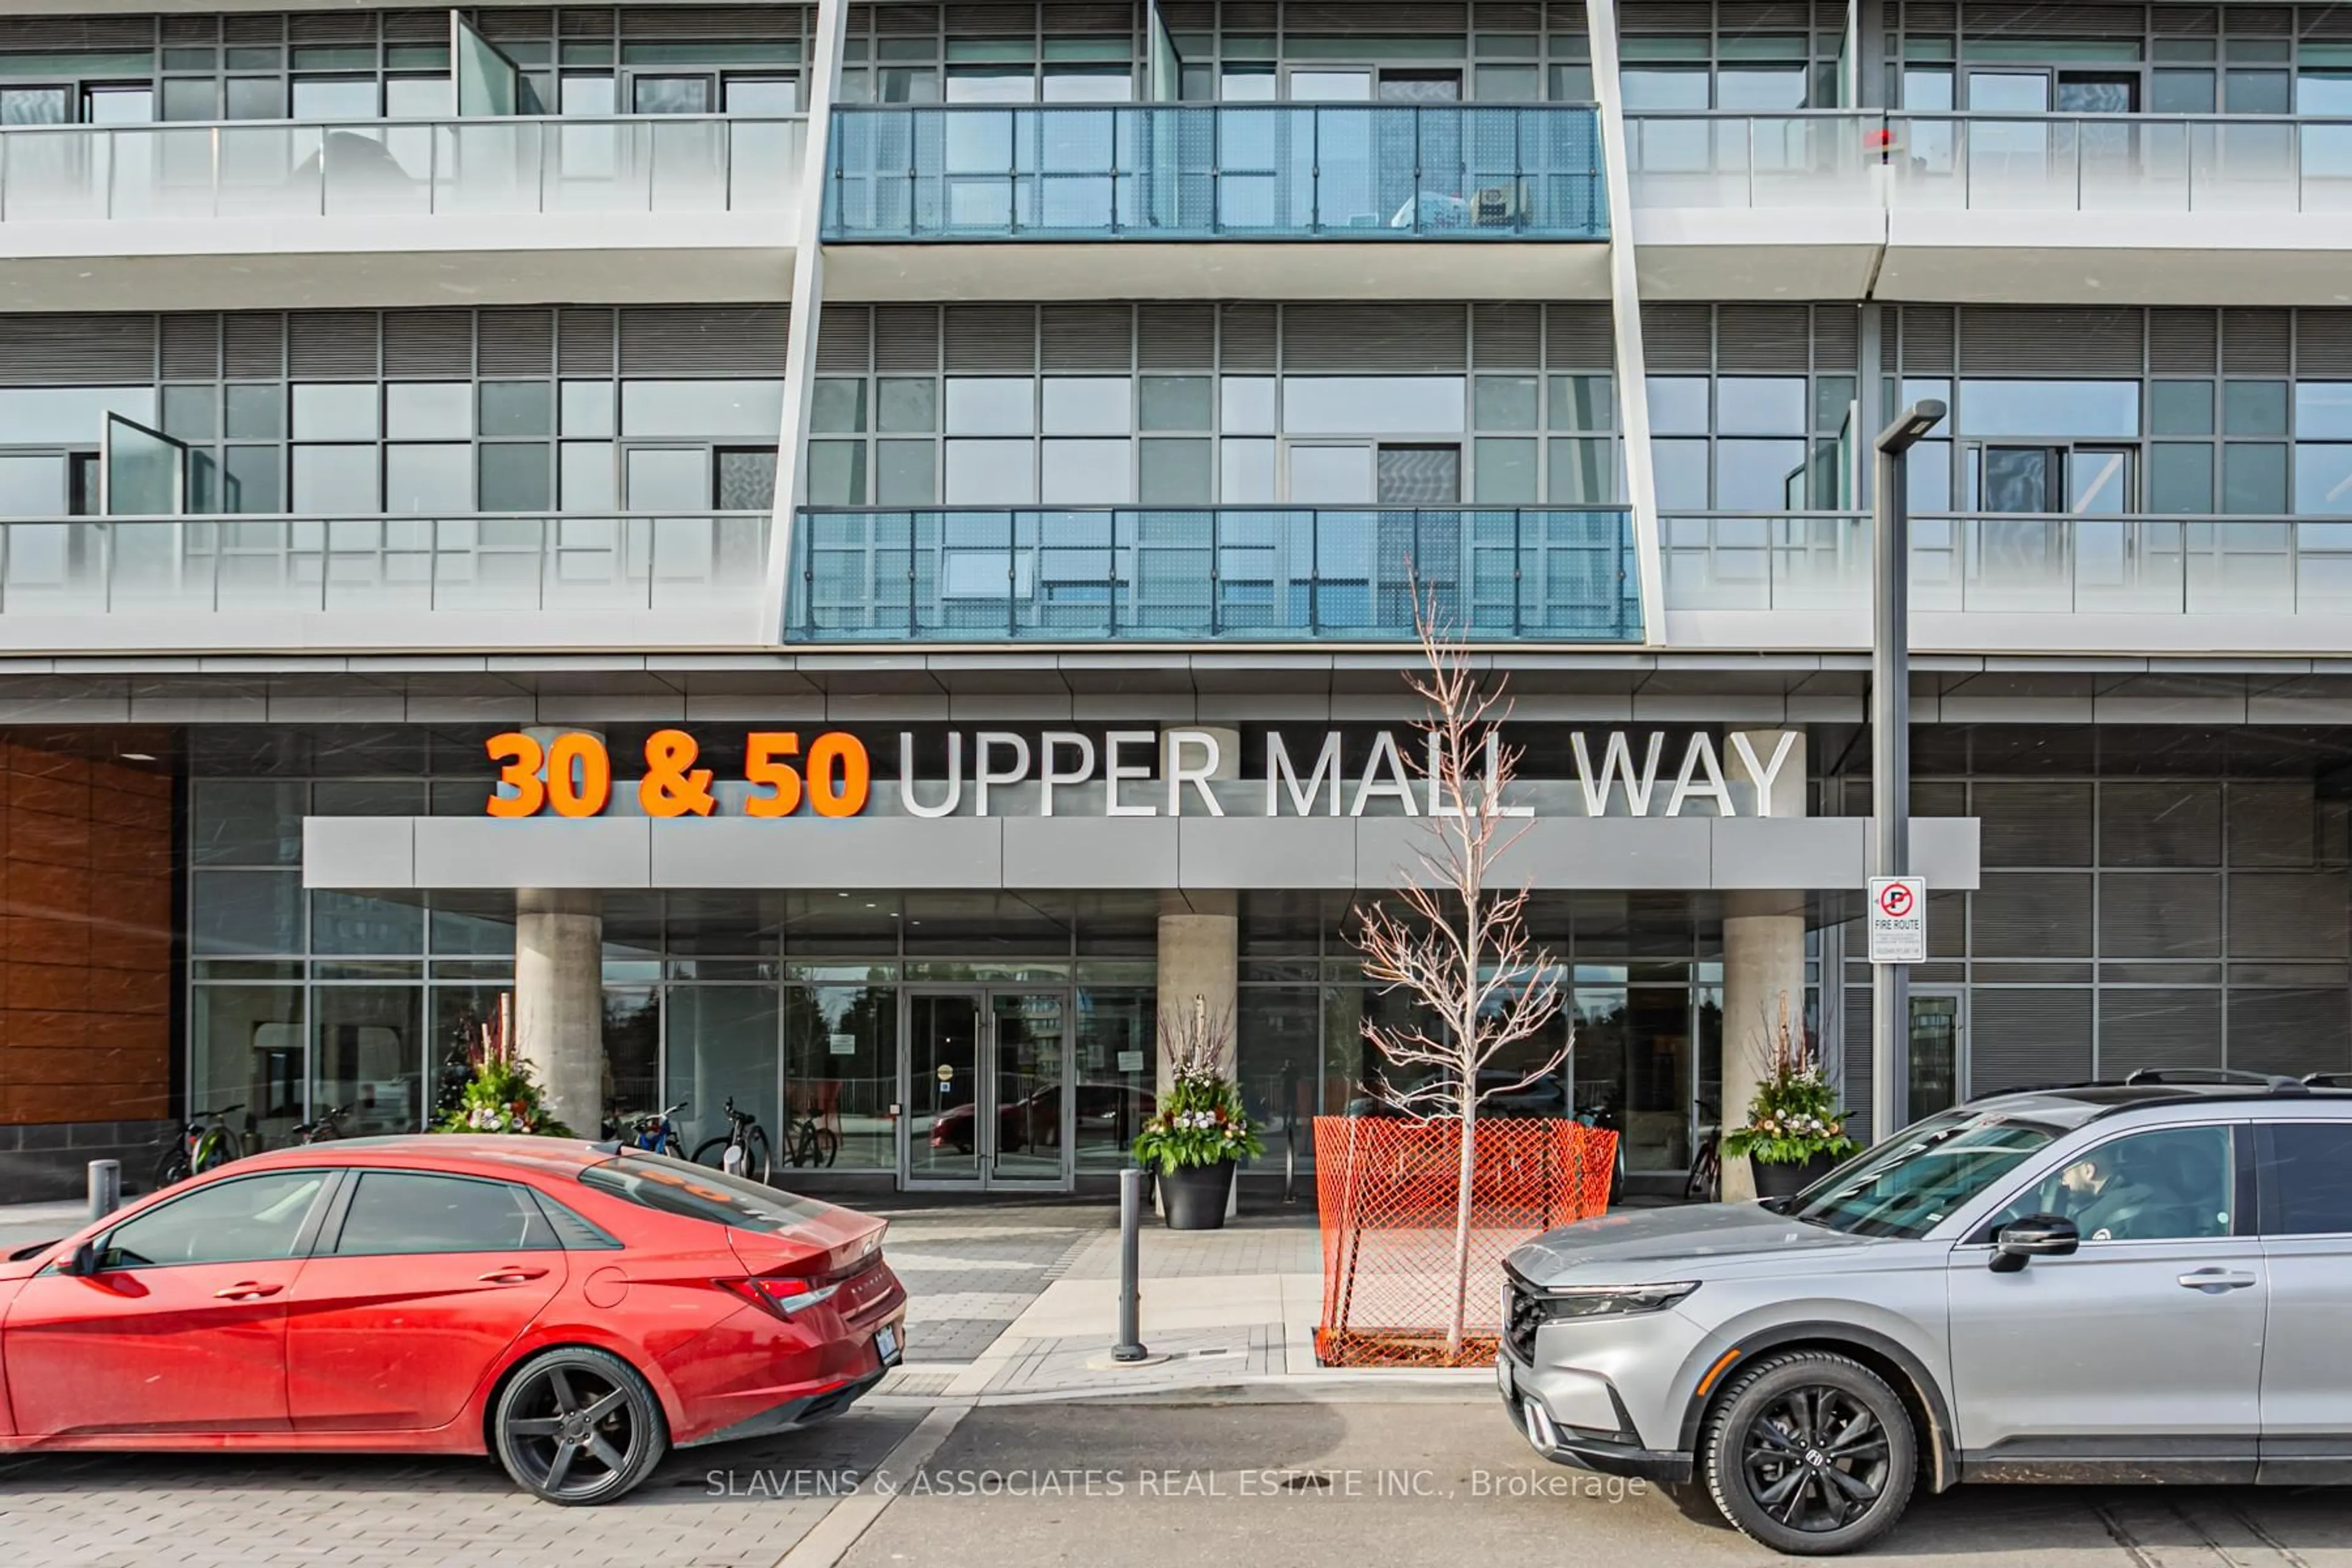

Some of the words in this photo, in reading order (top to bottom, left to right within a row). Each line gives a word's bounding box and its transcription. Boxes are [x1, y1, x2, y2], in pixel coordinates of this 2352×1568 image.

[486, 732, 609, 817] 30
[639, 729, 715, 817] &
[744, 732, 870, 817] 50
[900, 731, 1224, 817] UPPER
[1267, 731, 1535, 816] MALL
[1570, 731, 1798, 816] WAY
[1875, 920, 1891, 929] FIRE
[1894, 920, 1919, 929] ROUTE
